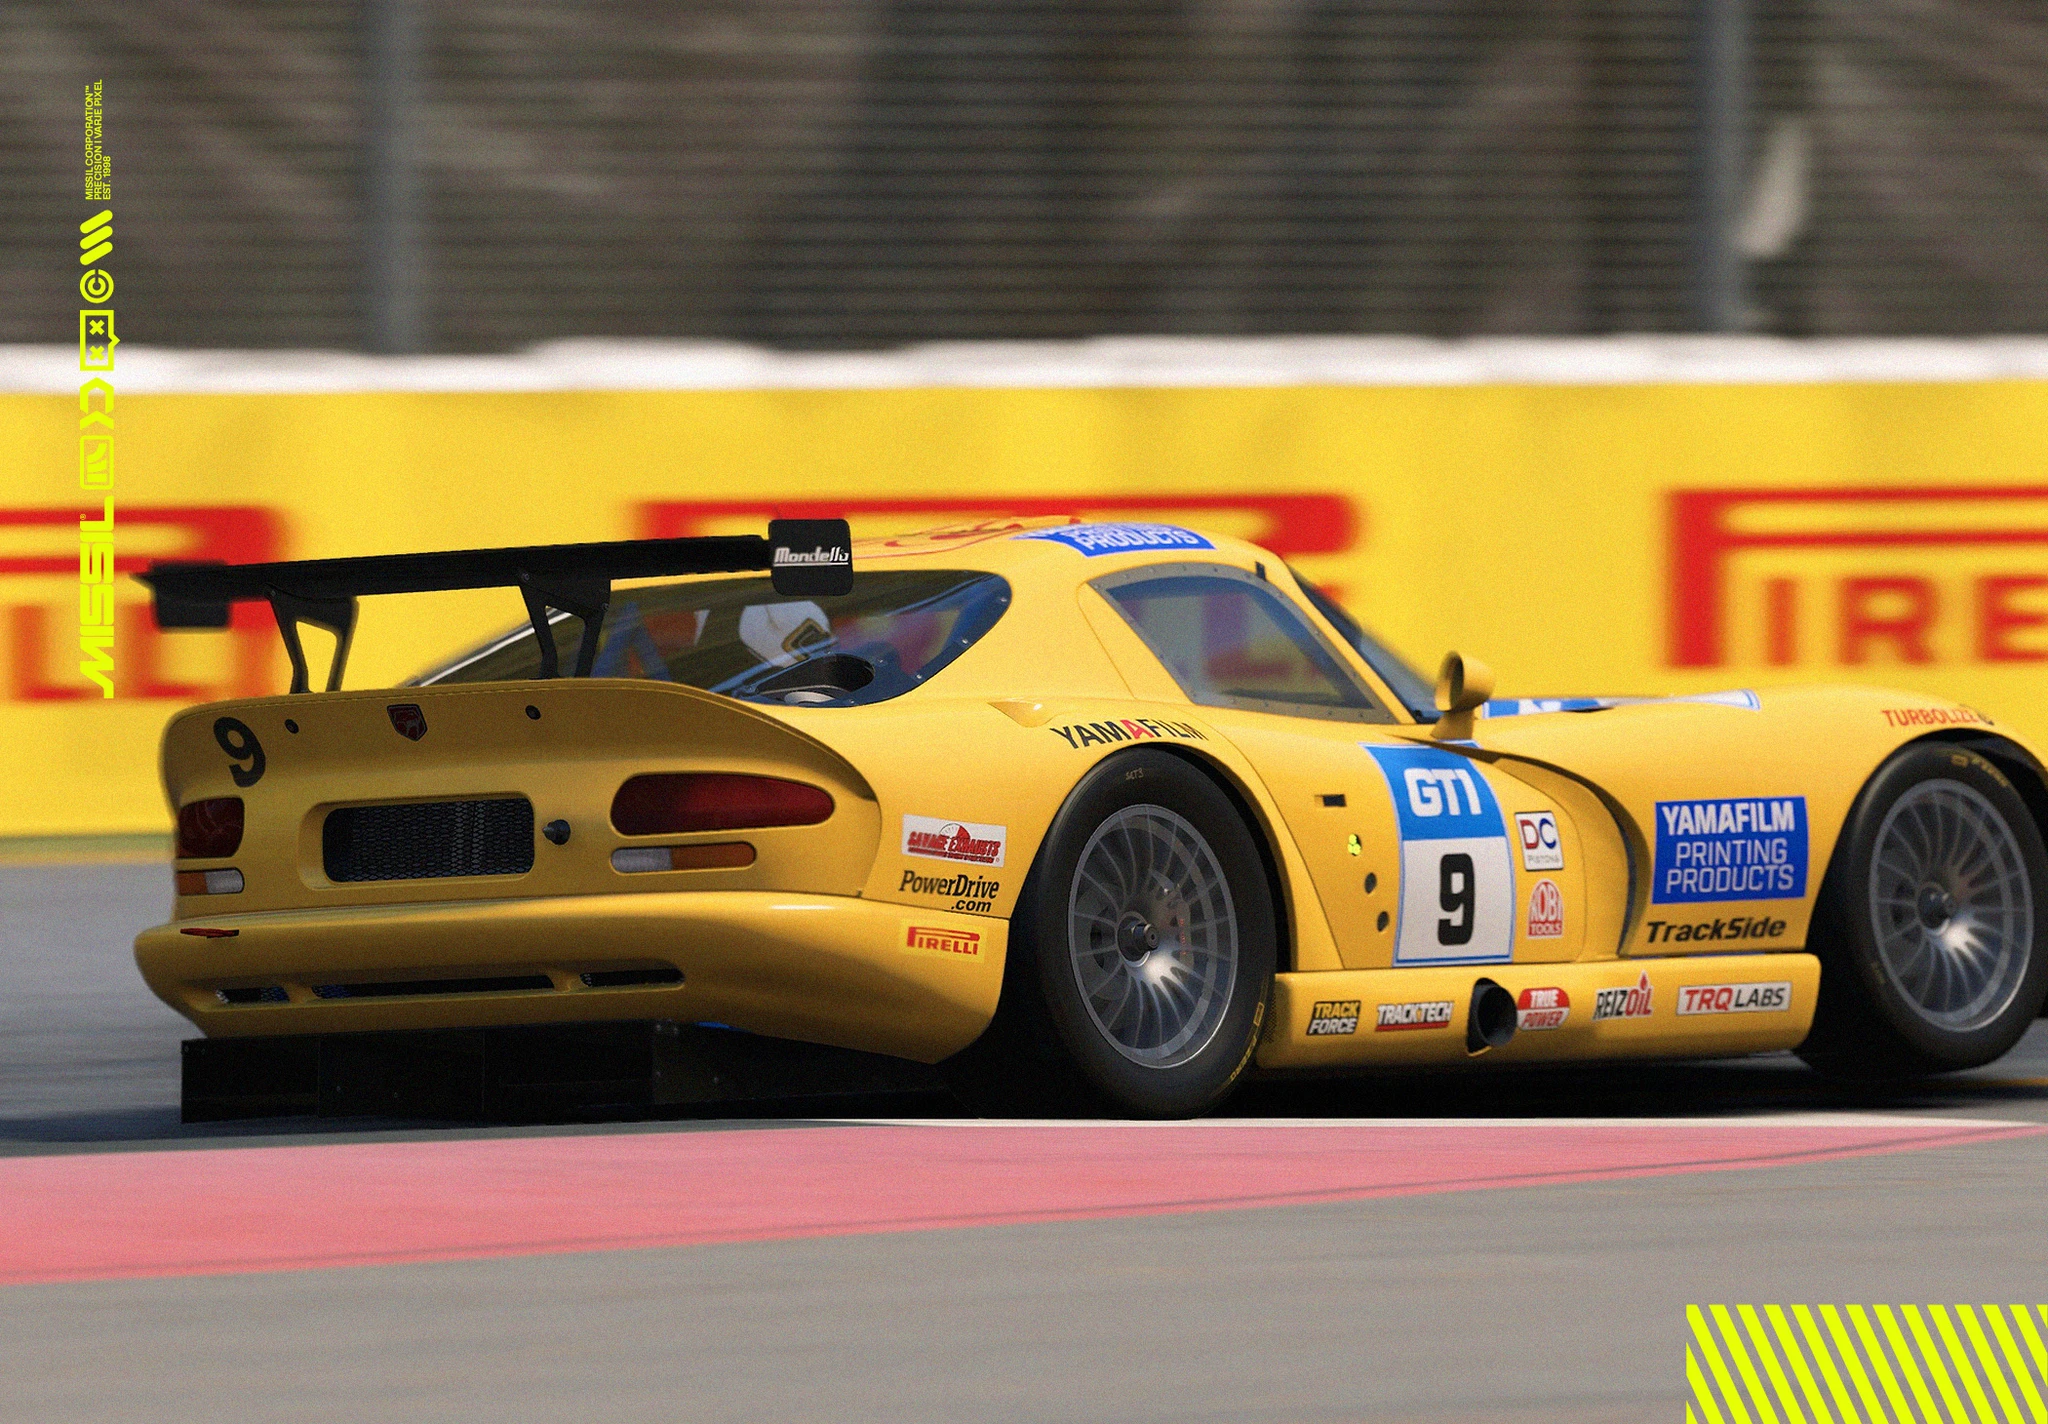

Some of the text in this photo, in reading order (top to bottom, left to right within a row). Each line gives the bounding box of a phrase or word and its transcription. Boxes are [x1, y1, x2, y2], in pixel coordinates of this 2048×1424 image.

[1049, 719, 1210, 750] YAMAFILM
[212, 715, 267, 788] 9
[1661, 800, 1795, 837] YAMAFILM
[1519, 817, 1557, 850] DC
[1676, 838, 1788, 868] PRINTING
[898, 869, 1000, 900] PowerDrive
[1666, 864, 1795, 895] PRODUCTS
[950, 899, 992, 913] .com
[1437, 853, 1476, 947] 9
[906, 926, 981, 955] PIRELLI
[1531, 923, 1562, 935] TOOLS
[1646, 916, 1787, 944] TrackSide
[1314, 1002, 1360, 1019] TRACK
[1530, 989, 1559, 1009] TRUE
[1308, 1017, 1358, 1035] FORCE
[1522, 1010, 1564, 1028] POWER
